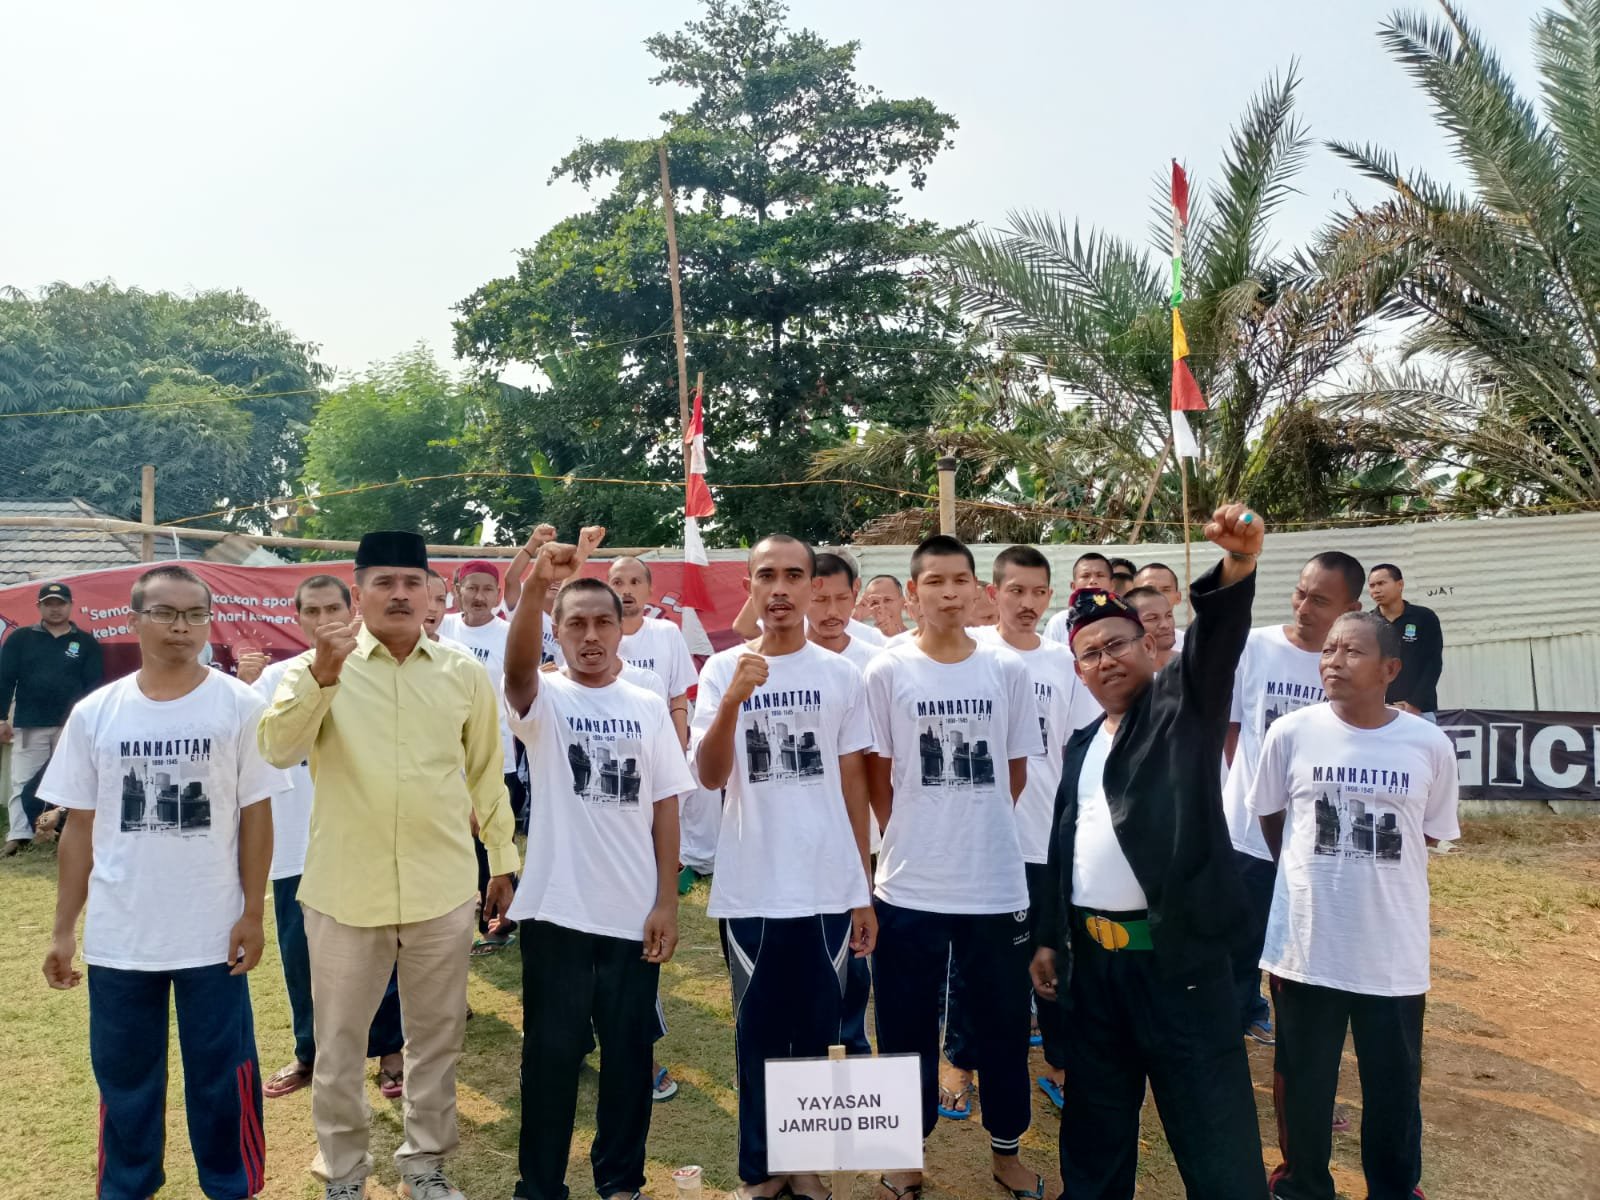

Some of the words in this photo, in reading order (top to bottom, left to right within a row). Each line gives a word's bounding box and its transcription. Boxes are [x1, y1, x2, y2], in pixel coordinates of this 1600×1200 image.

[218, 611, 246, 622] hari
[743, 690, 821, 712] MANHATTAN
[917, 699, 992, 716] MANHATTAN
[120, 738, 211, 757] MANHATTAN
[1313, 766, 1409, 788] MANHATTAN
[1388, 786, 1408, 795] CITY
[797, 1094, 881, 1110] YAYASAN
[778, 1117, 852, 1133] JAMRUD
[858, 1115, 899, 1130] BIRU
